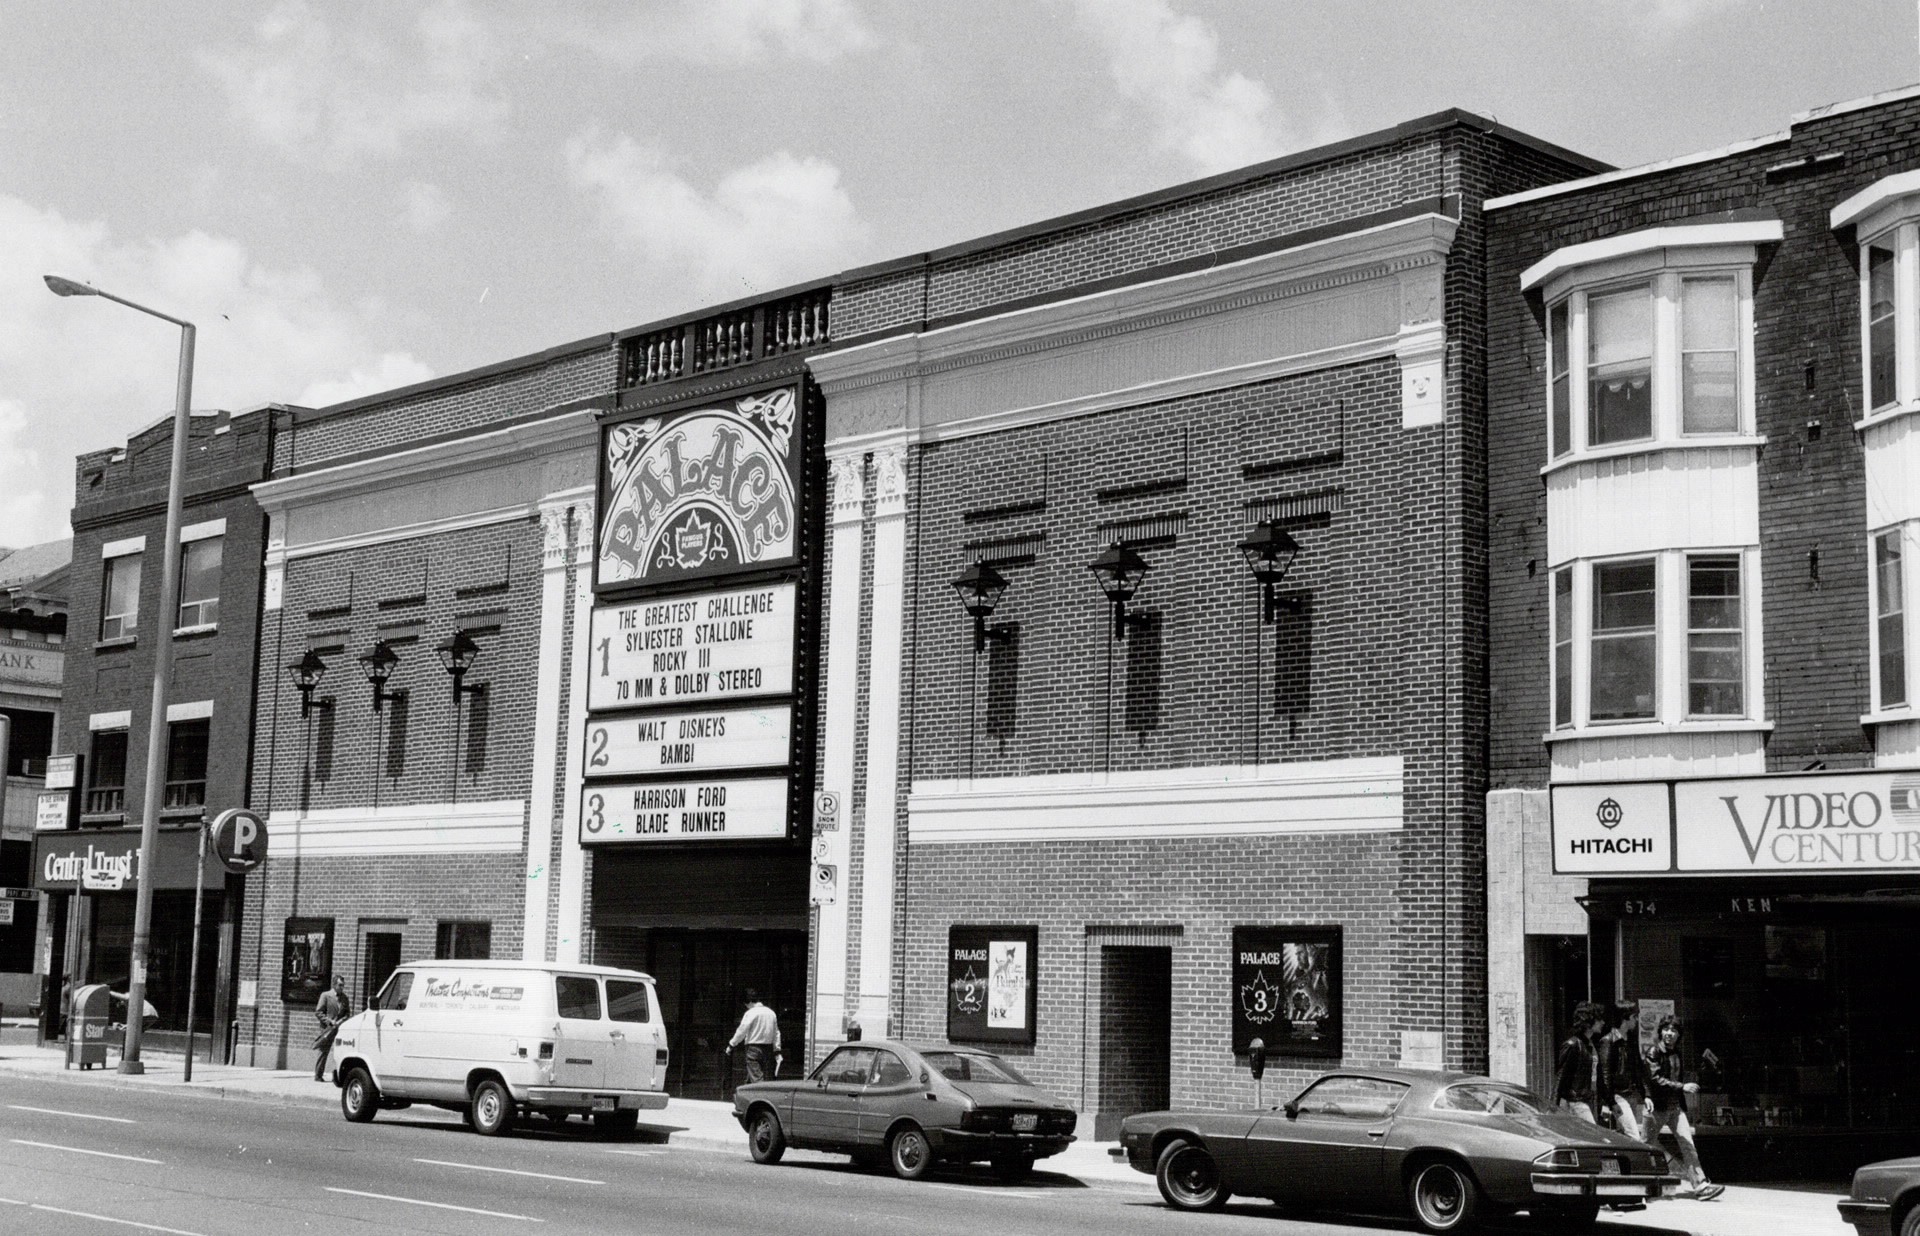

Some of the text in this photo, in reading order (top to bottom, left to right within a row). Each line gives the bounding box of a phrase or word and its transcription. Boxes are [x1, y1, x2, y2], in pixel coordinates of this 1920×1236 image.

[599, 423, 793, 578] PALACE
[619, 592, 774, 630] THE GREATEST CHALLENGE
[626, 619, 753, 652] SYLVESTER STALLONE
[596, 637, 611, 677] 1
[653, 648, 710, 673] ROCKY III
[617, 667, 762, 700] 70 MM & DOLBY STEREO
[638, 717, 725, 742] WALT DISNEYS
[590, 728, 609, 768] 2
[633, 787, 727, 810] HARRISON FORD
[586, 793, 605, 834] 3
[636, 811, 726, 834] BLADE RUNNER
[816, 822, 836, 830] ROUTE
[1719, 791, 1882, 865] VIDEO
[1571, 838, 1653, 854] HITACHI
[95, 850, 133, 880] Trust
[1625, 901, 1657, 915] 674
[954, 948, 988, 961] PALACE
[1240, 952, 1280, 965] PALACE
[964, 983, 976, 1003] 2
[1254, 990, 1267, 1012] 3
[85, 1023, 105, 1038] Star
